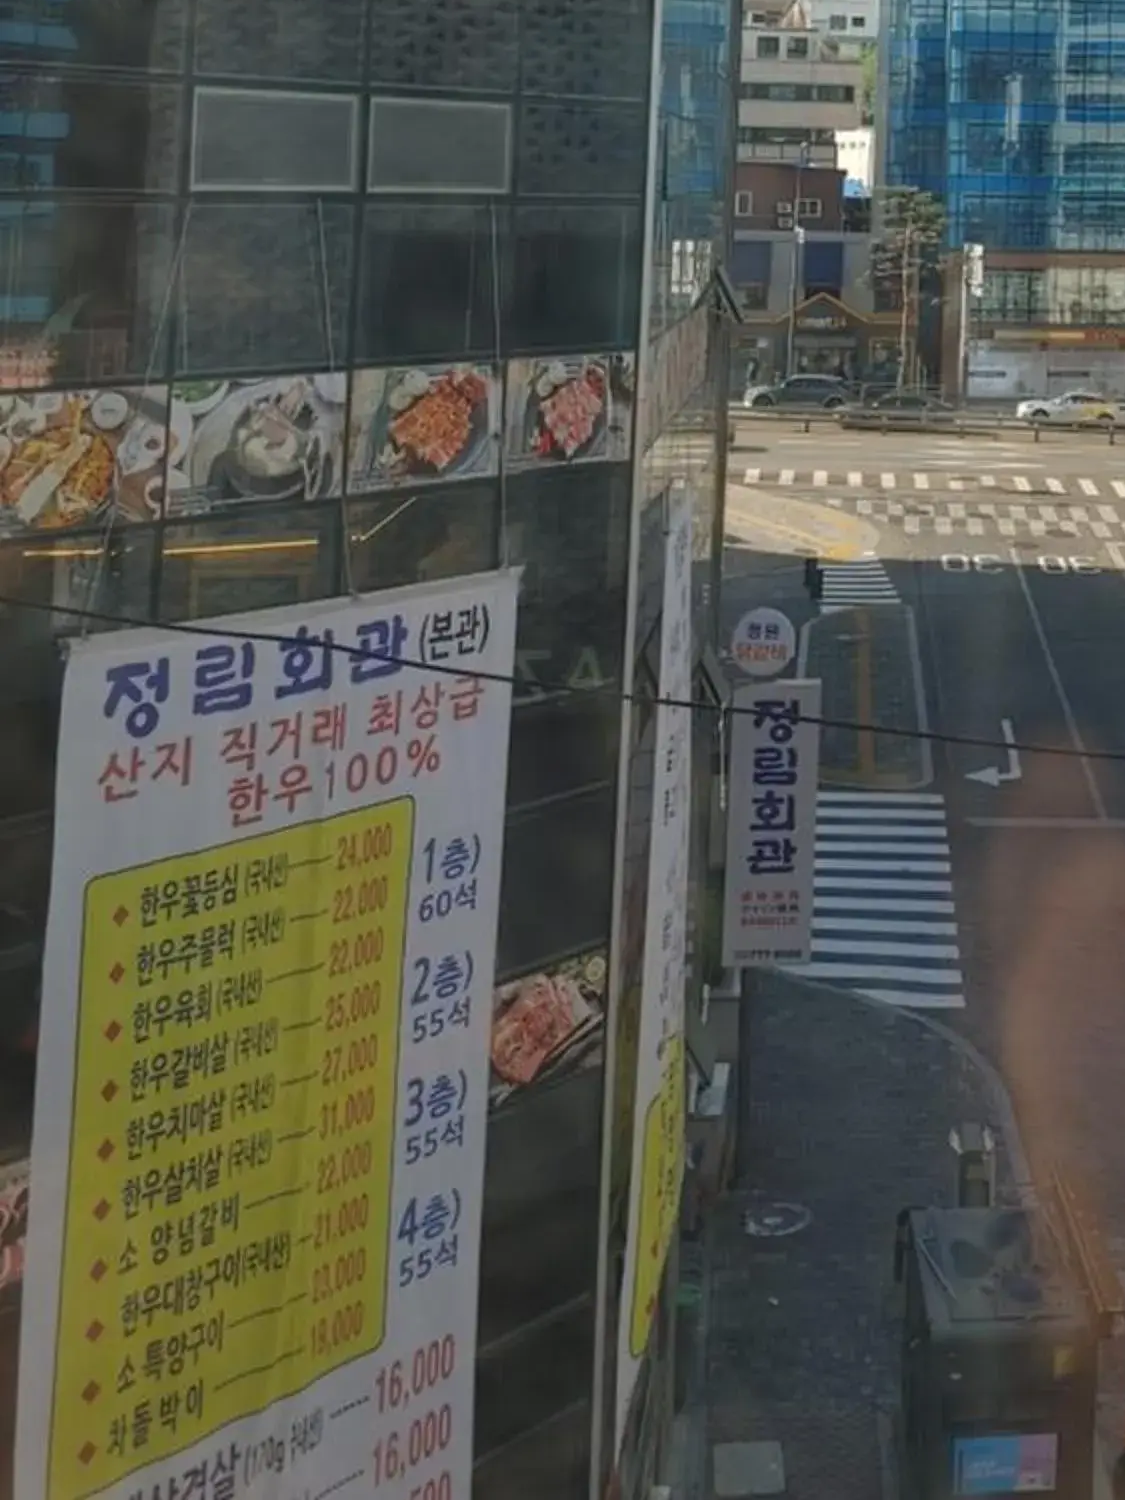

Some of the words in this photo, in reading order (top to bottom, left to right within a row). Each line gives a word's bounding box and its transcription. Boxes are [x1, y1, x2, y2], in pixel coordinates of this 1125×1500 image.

[104, 614, 408, 739] 정림회관
[419, 604, 490, 665] (본관)
[97, 736, 193, 803] 산지
[219, 702, 347, 772] 직거래
[366, 675, 485, 738] 최상급
[747, 699, 799, 876] 정림회관
[140, 863, 239, 928] 한우꽃등심
[418, 878, 477, 923] 60석
[136, 918, 236, 987] 한우주물럭
[132, 980, 213, 1044] 한우육회
[412, 996, 471, 1044] 55석
[125, 1087, 227, 1161] 한우치마살
[405, 1114, 465, 1165] 55석
[117, 1237, 139, 1276] 소
[399, 1234, 459, 1288] 55석
[116, 1354, 136, 1394] 소
[375, 1332, 455, 1414] 16,000
[372, 1403, 452, 1488] 16,000
